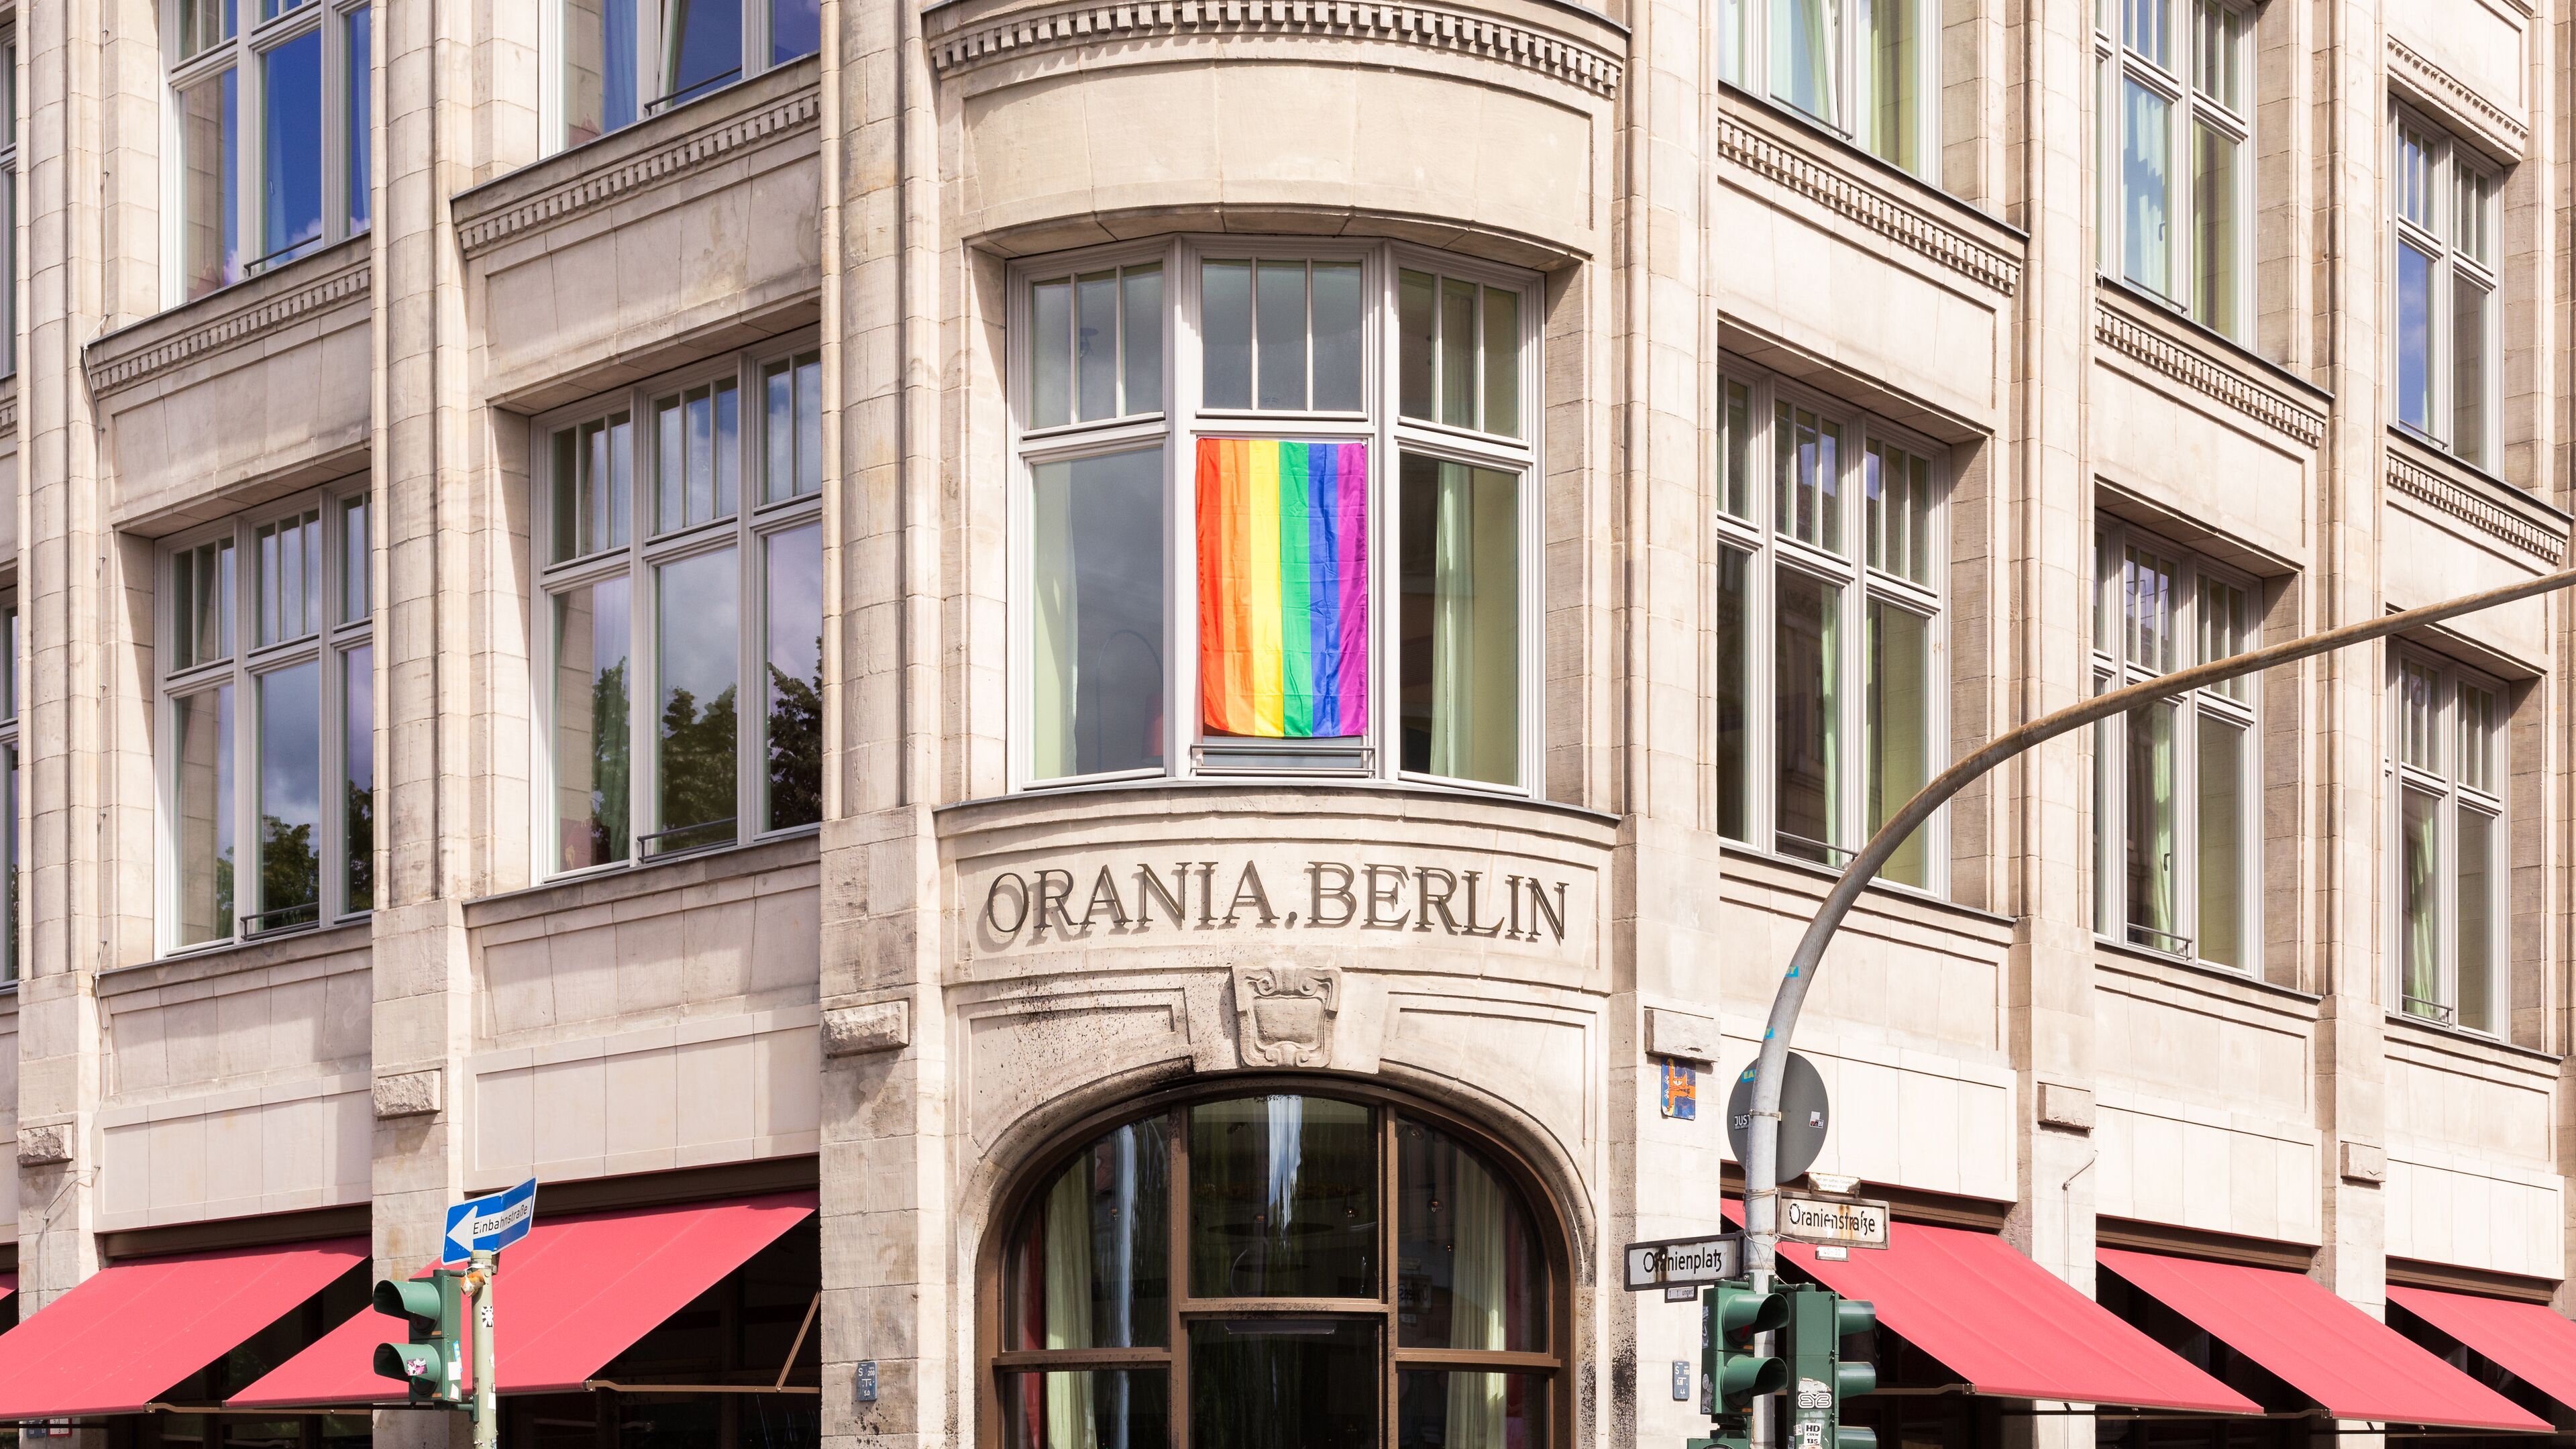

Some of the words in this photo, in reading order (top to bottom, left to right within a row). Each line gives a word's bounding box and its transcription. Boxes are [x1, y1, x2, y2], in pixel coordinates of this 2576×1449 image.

[473, 1204, 528, 1235] Einbahnstraße
[1644, 1247, 1722, 1274] Onienplatz
[859, 1368, 863, 1376] S
